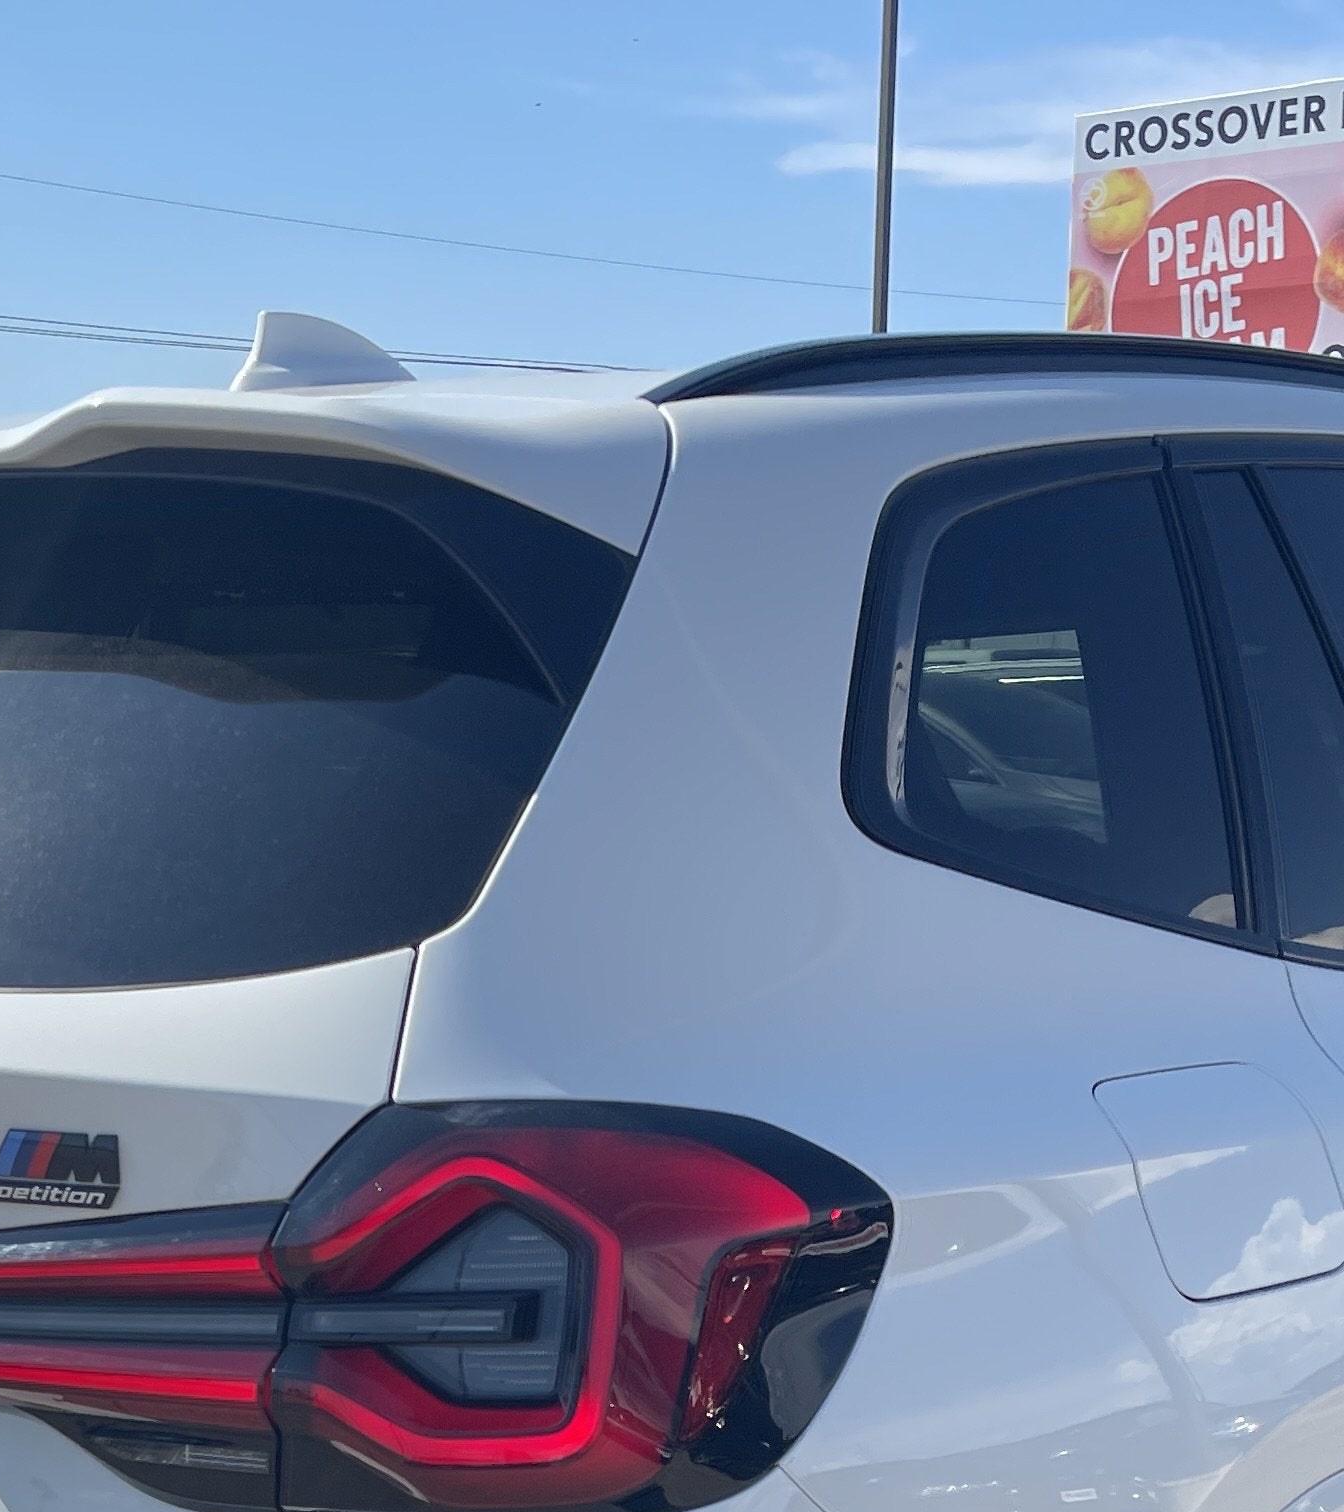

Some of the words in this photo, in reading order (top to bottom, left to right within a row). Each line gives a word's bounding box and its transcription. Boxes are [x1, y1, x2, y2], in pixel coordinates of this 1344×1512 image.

[1085, 95, 1326, 161] CROSSOVER
[1147, 200, 1285, 286] PEACH
[1180, 273, 1246, 340] ICE
